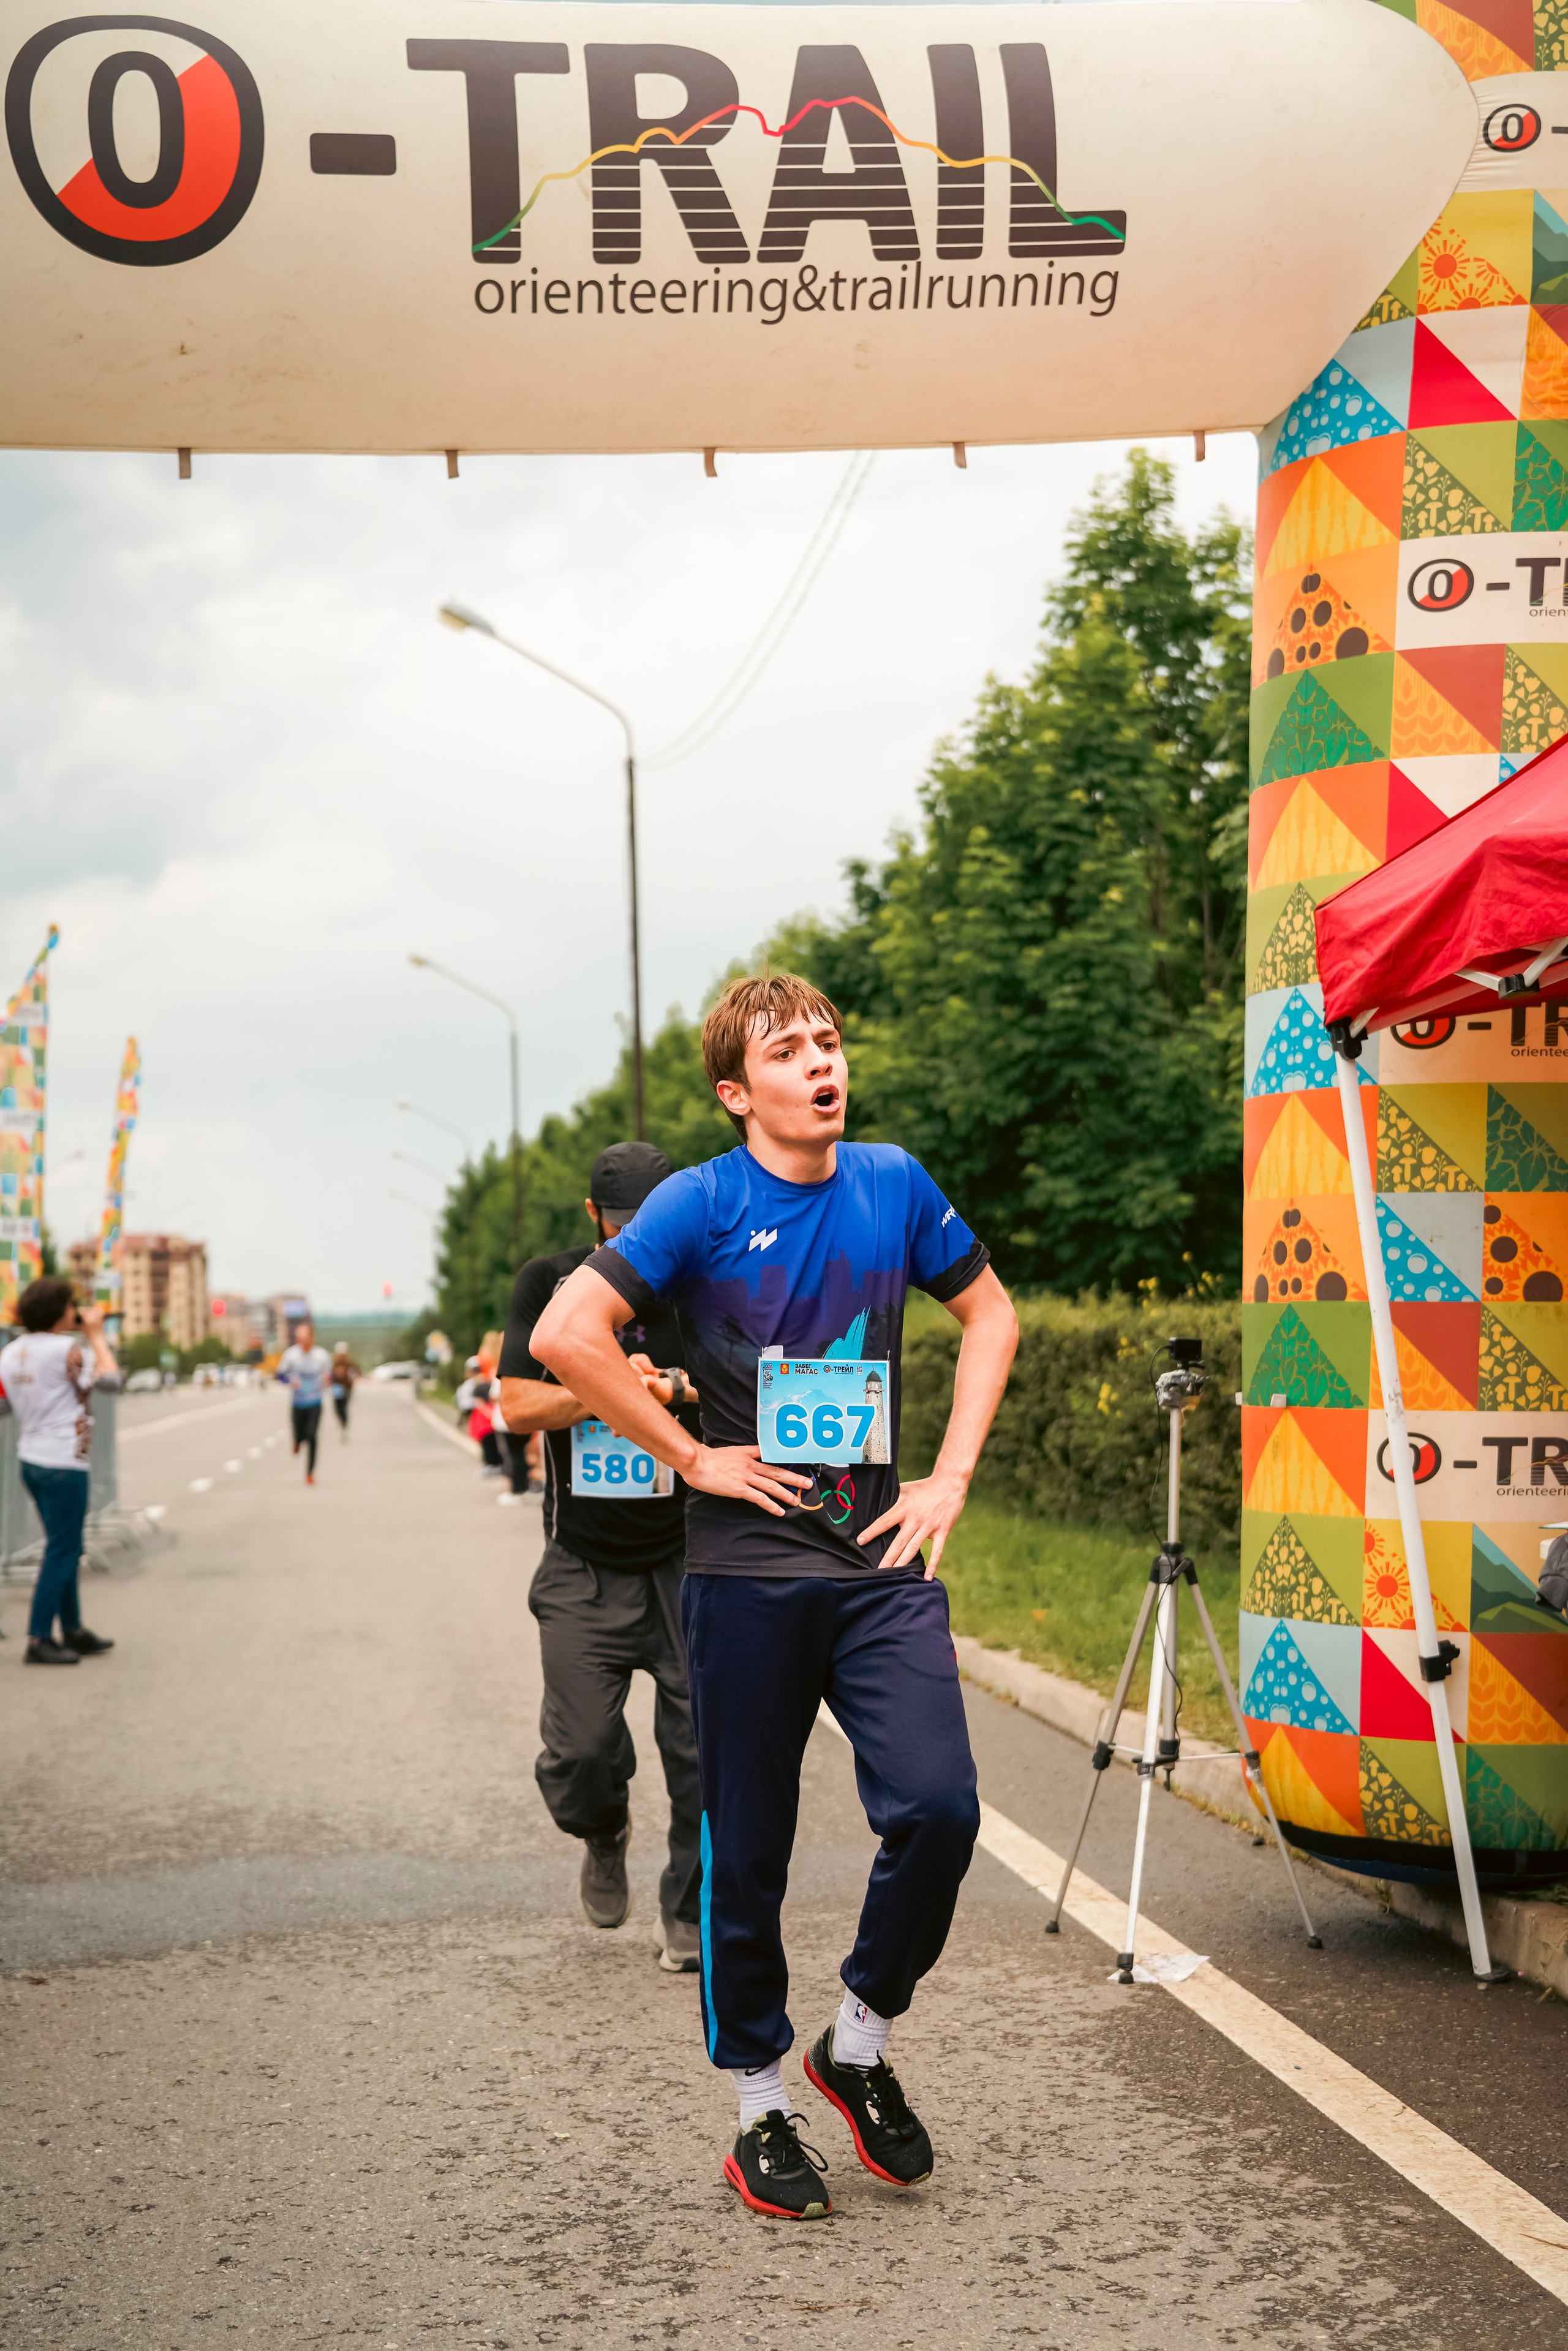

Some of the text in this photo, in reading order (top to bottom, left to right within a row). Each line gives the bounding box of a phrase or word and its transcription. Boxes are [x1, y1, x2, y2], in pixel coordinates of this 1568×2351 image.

[474, 260, 1120, 325] orienteering&trailrunning
[1529, 606, 1568, 617] orien
[775, 1403, 875, 1449] 667
[582, 1453, 655, 1484] 580
[1496, 1485, 1568, 1496] orienteeri
